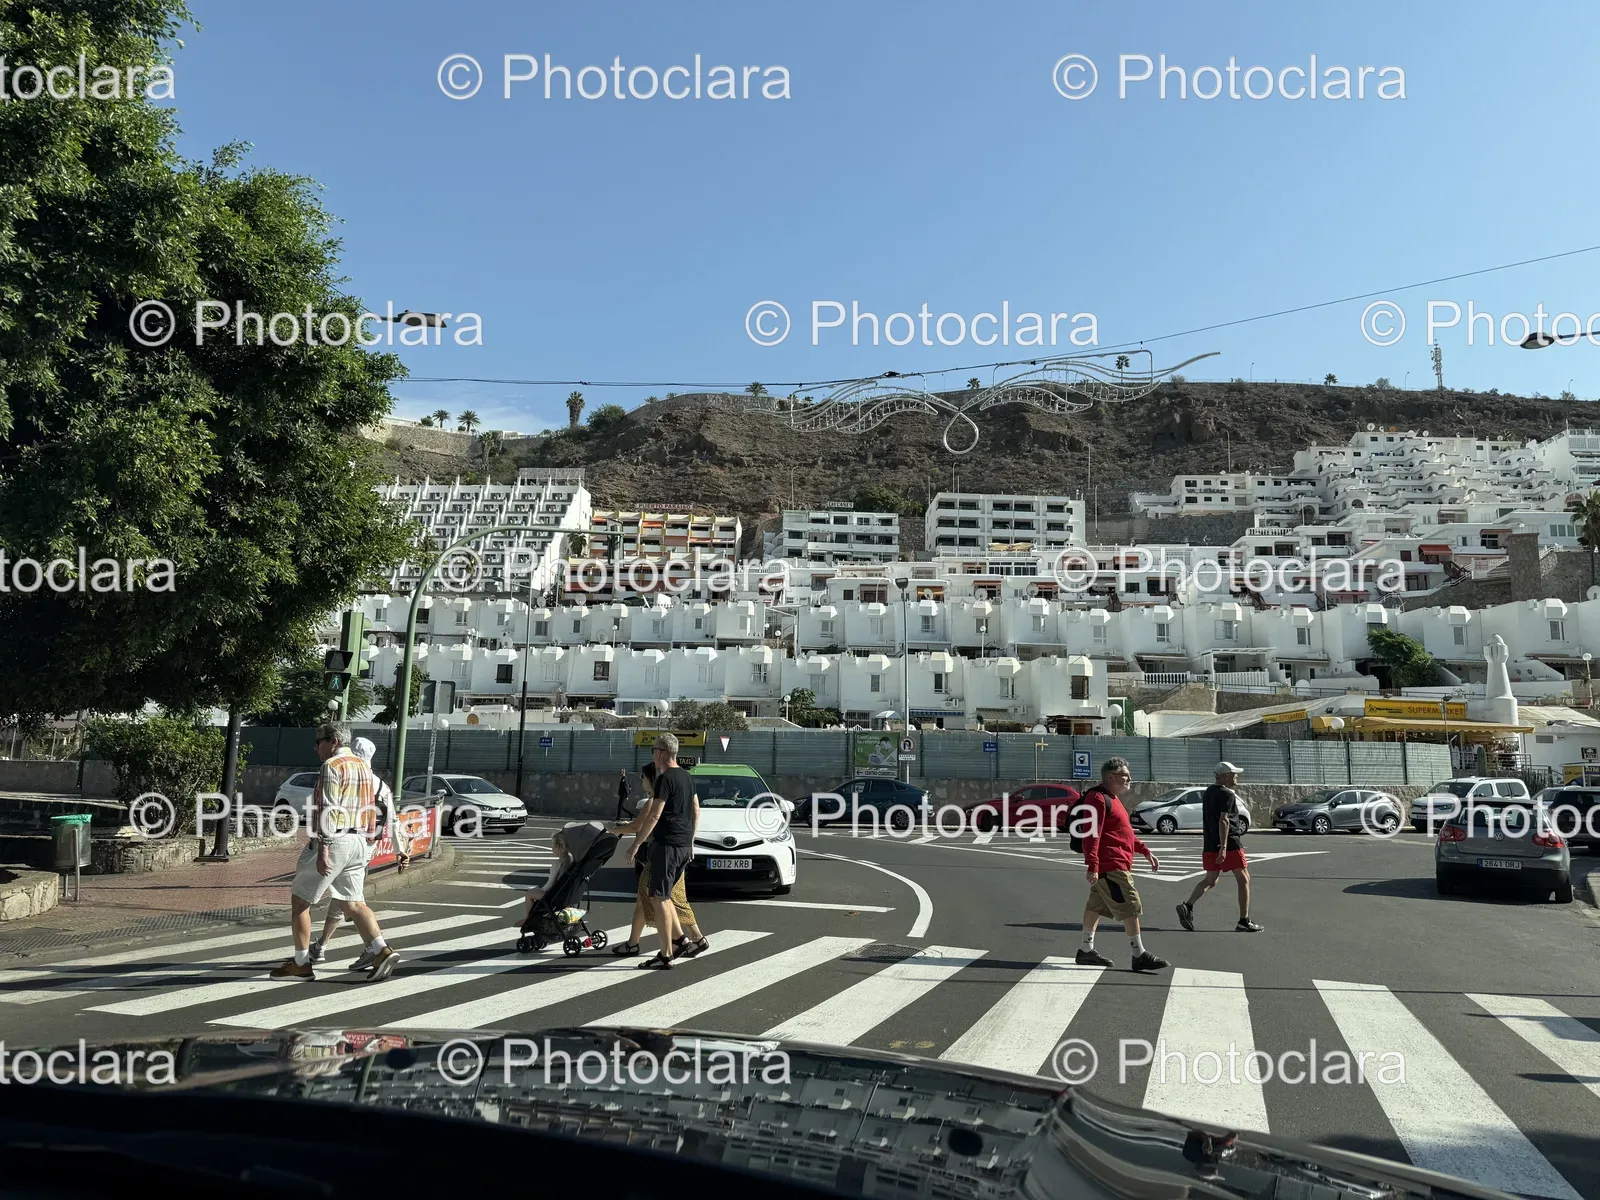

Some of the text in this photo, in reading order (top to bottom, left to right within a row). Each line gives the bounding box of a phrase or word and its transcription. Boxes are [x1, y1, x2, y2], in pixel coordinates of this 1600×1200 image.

[1407, 706, 1463, 716] SUPERMRKET
[711, 859, 750, 869] 9012 KRB
